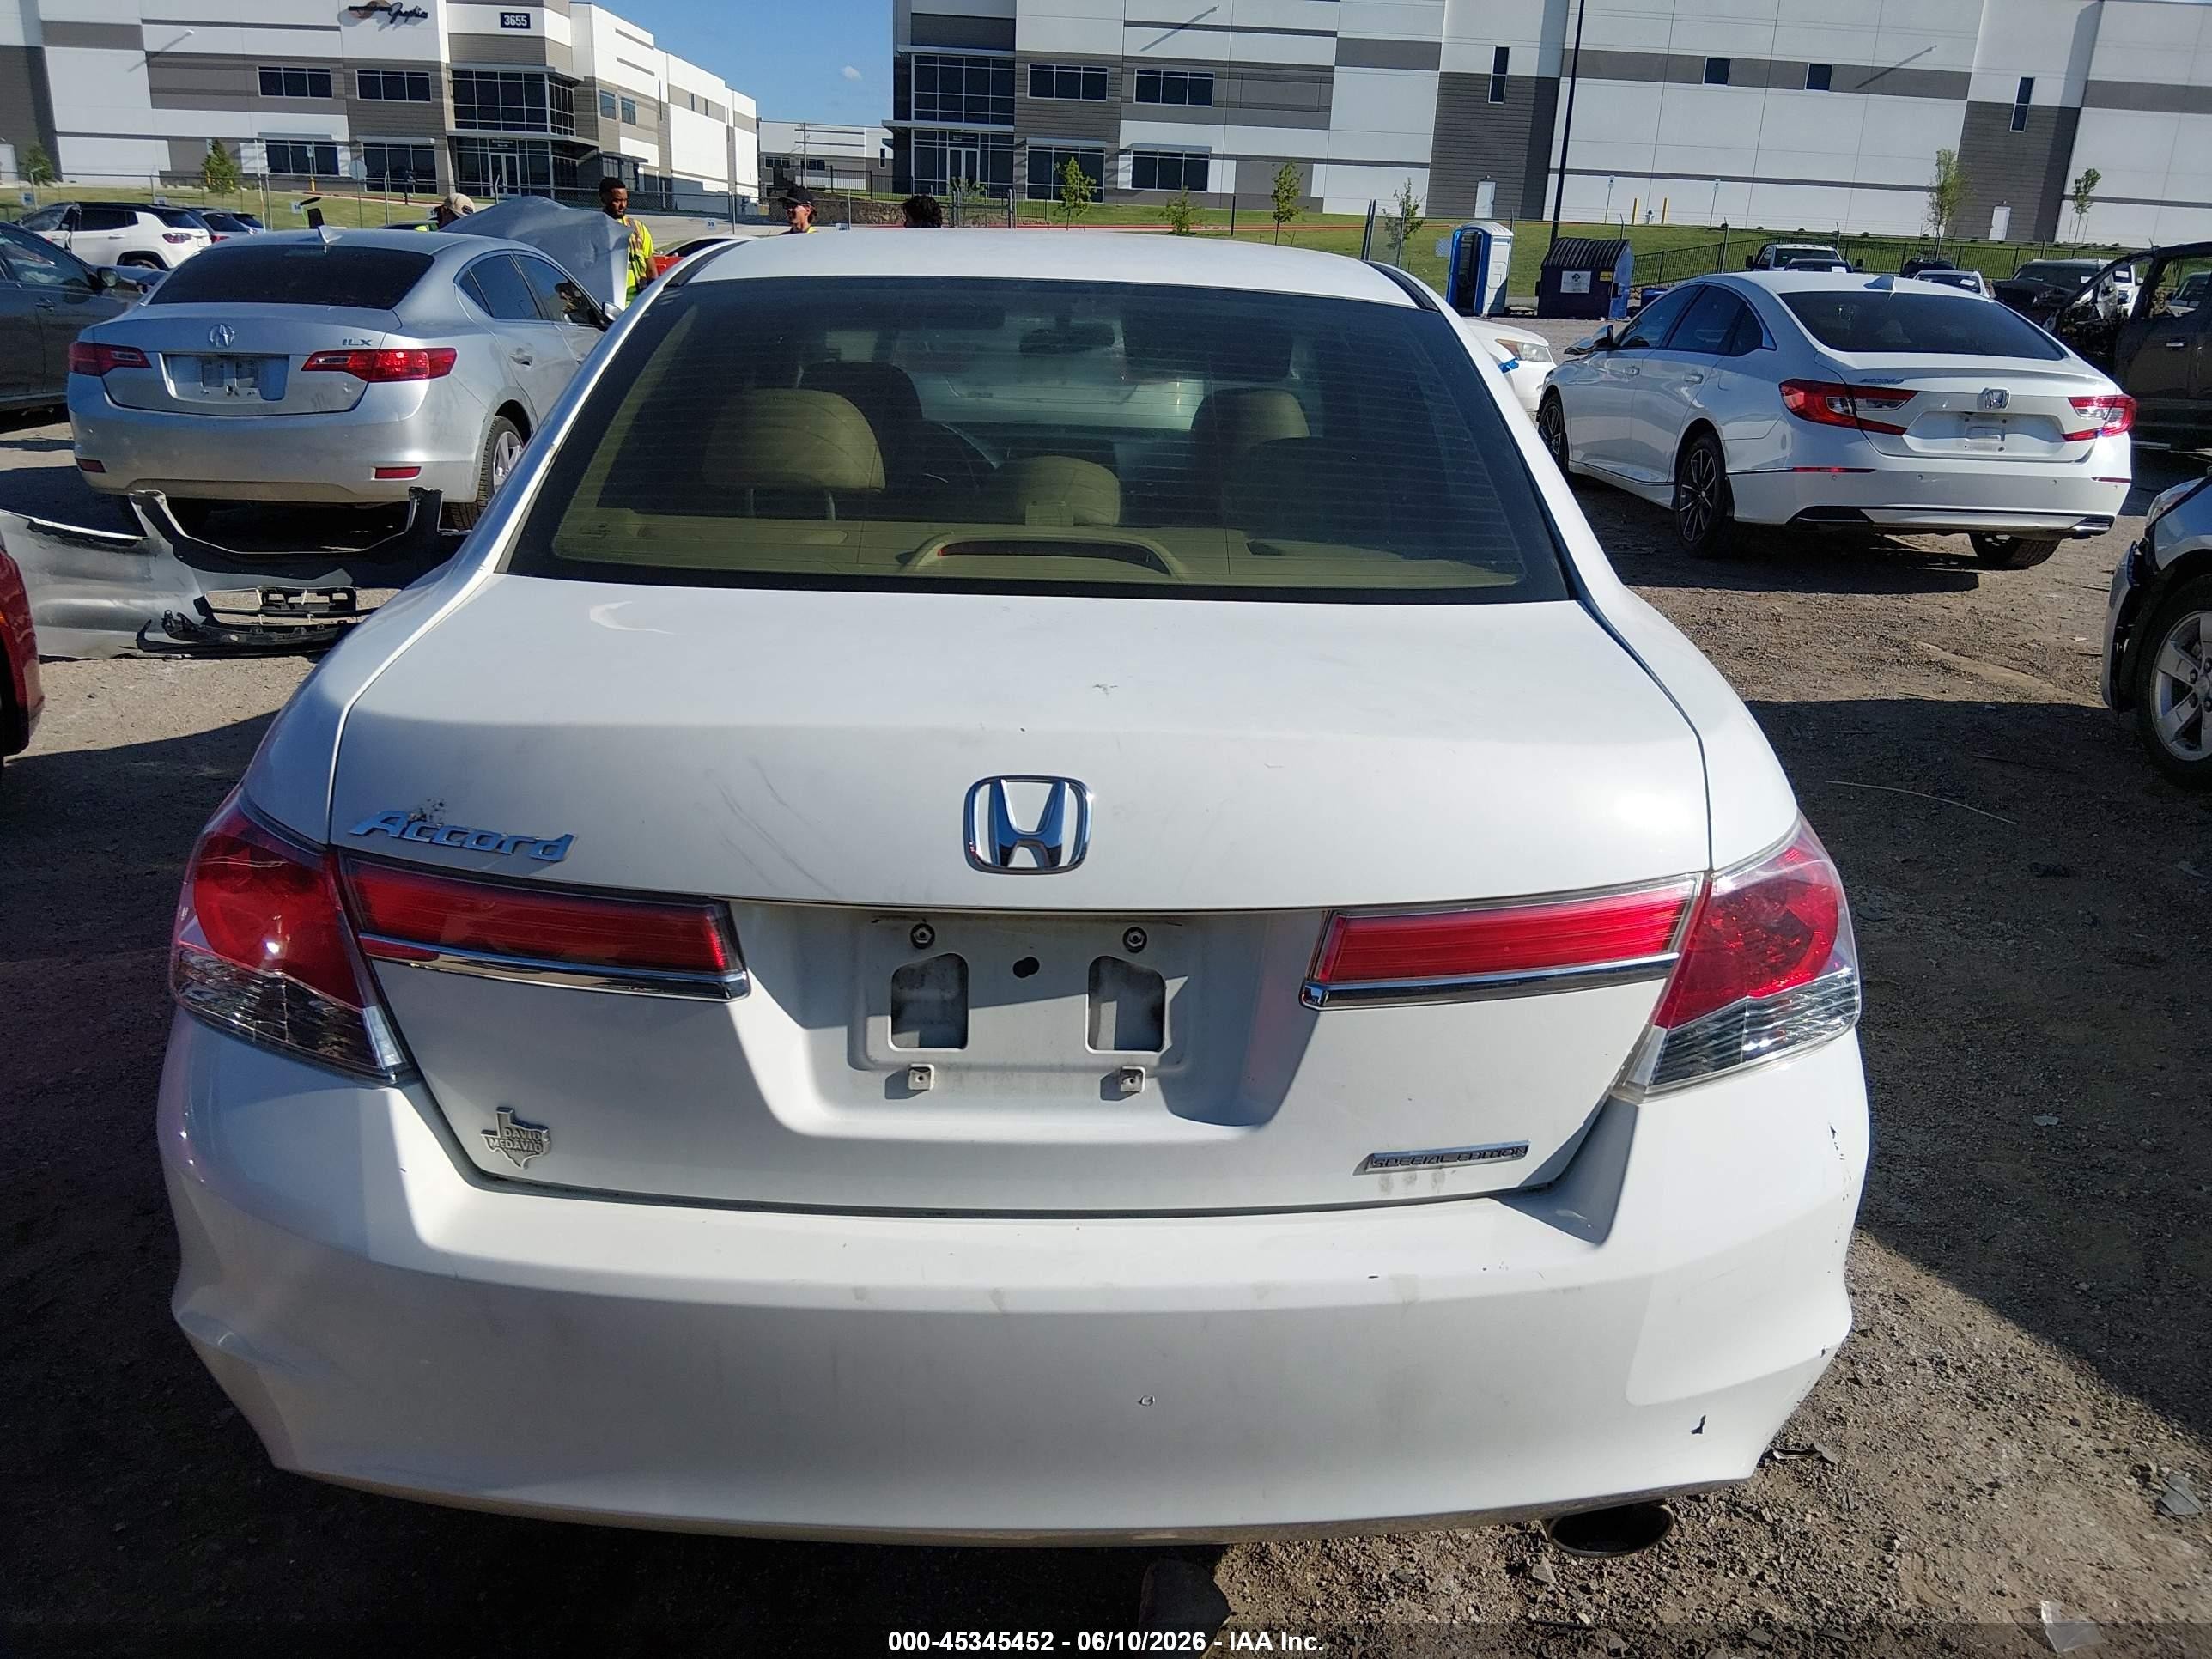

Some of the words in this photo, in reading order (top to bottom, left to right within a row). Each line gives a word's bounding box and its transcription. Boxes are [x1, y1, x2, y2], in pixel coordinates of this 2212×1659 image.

[503, 14, 527, 26] 3655
[348, 810, 577, 861] Accord
[504, 1127, 542, 1141] DAVID
[1373, 1154, 1449, 1167] SPECIAL
[1457, 1145, 1529, 1162] EDITION
